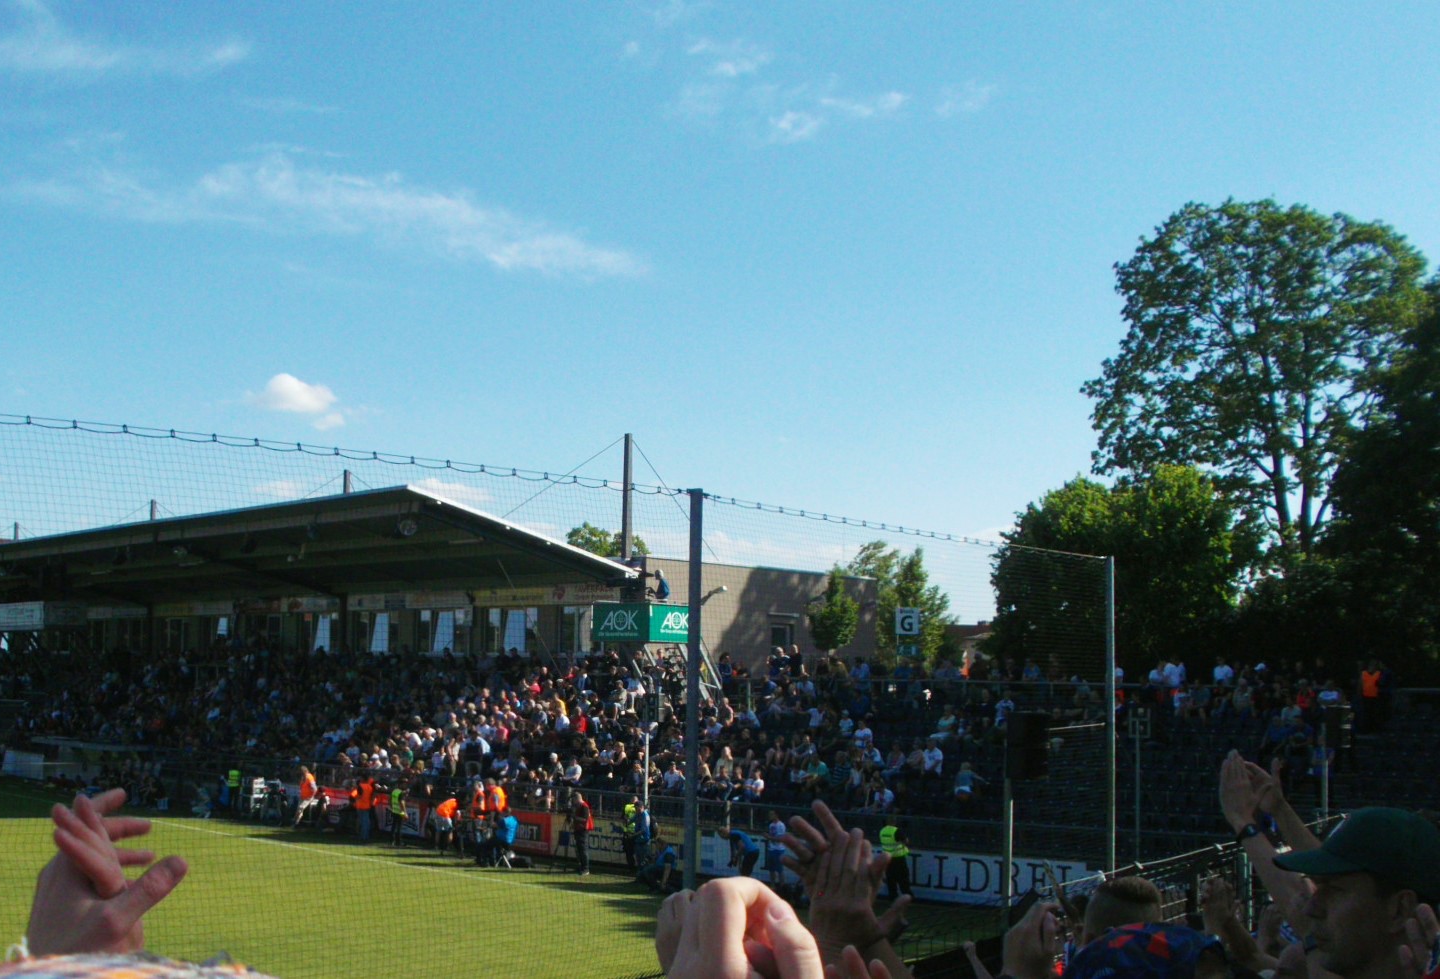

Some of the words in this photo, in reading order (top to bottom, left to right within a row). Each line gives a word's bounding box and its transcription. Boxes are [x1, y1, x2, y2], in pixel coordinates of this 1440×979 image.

[600, 609, 639, 631] AOK
[661, 611, 688, 630] AOK
[901, 615, 913, 632] G
